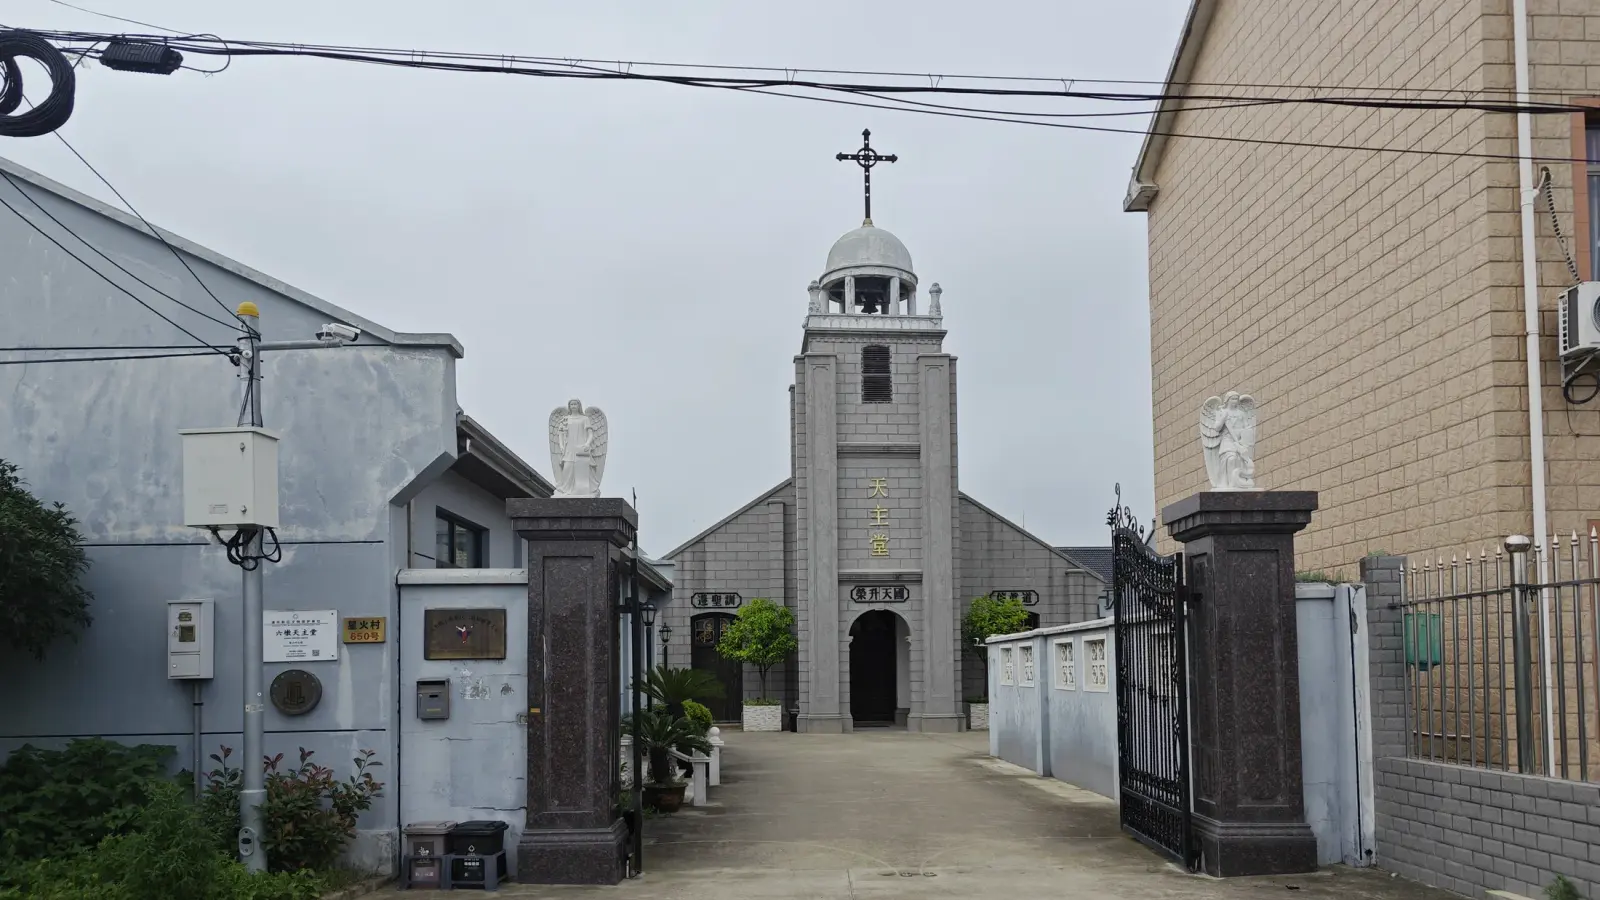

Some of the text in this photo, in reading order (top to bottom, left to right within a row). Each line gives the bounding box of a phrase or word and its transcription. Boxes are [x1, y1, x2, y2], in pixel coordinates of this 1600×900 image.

[868, 477, 890, 557] 天主堂
[347, 619, 381, 630] 星火村
[350, 631, 380, 641] 650号
